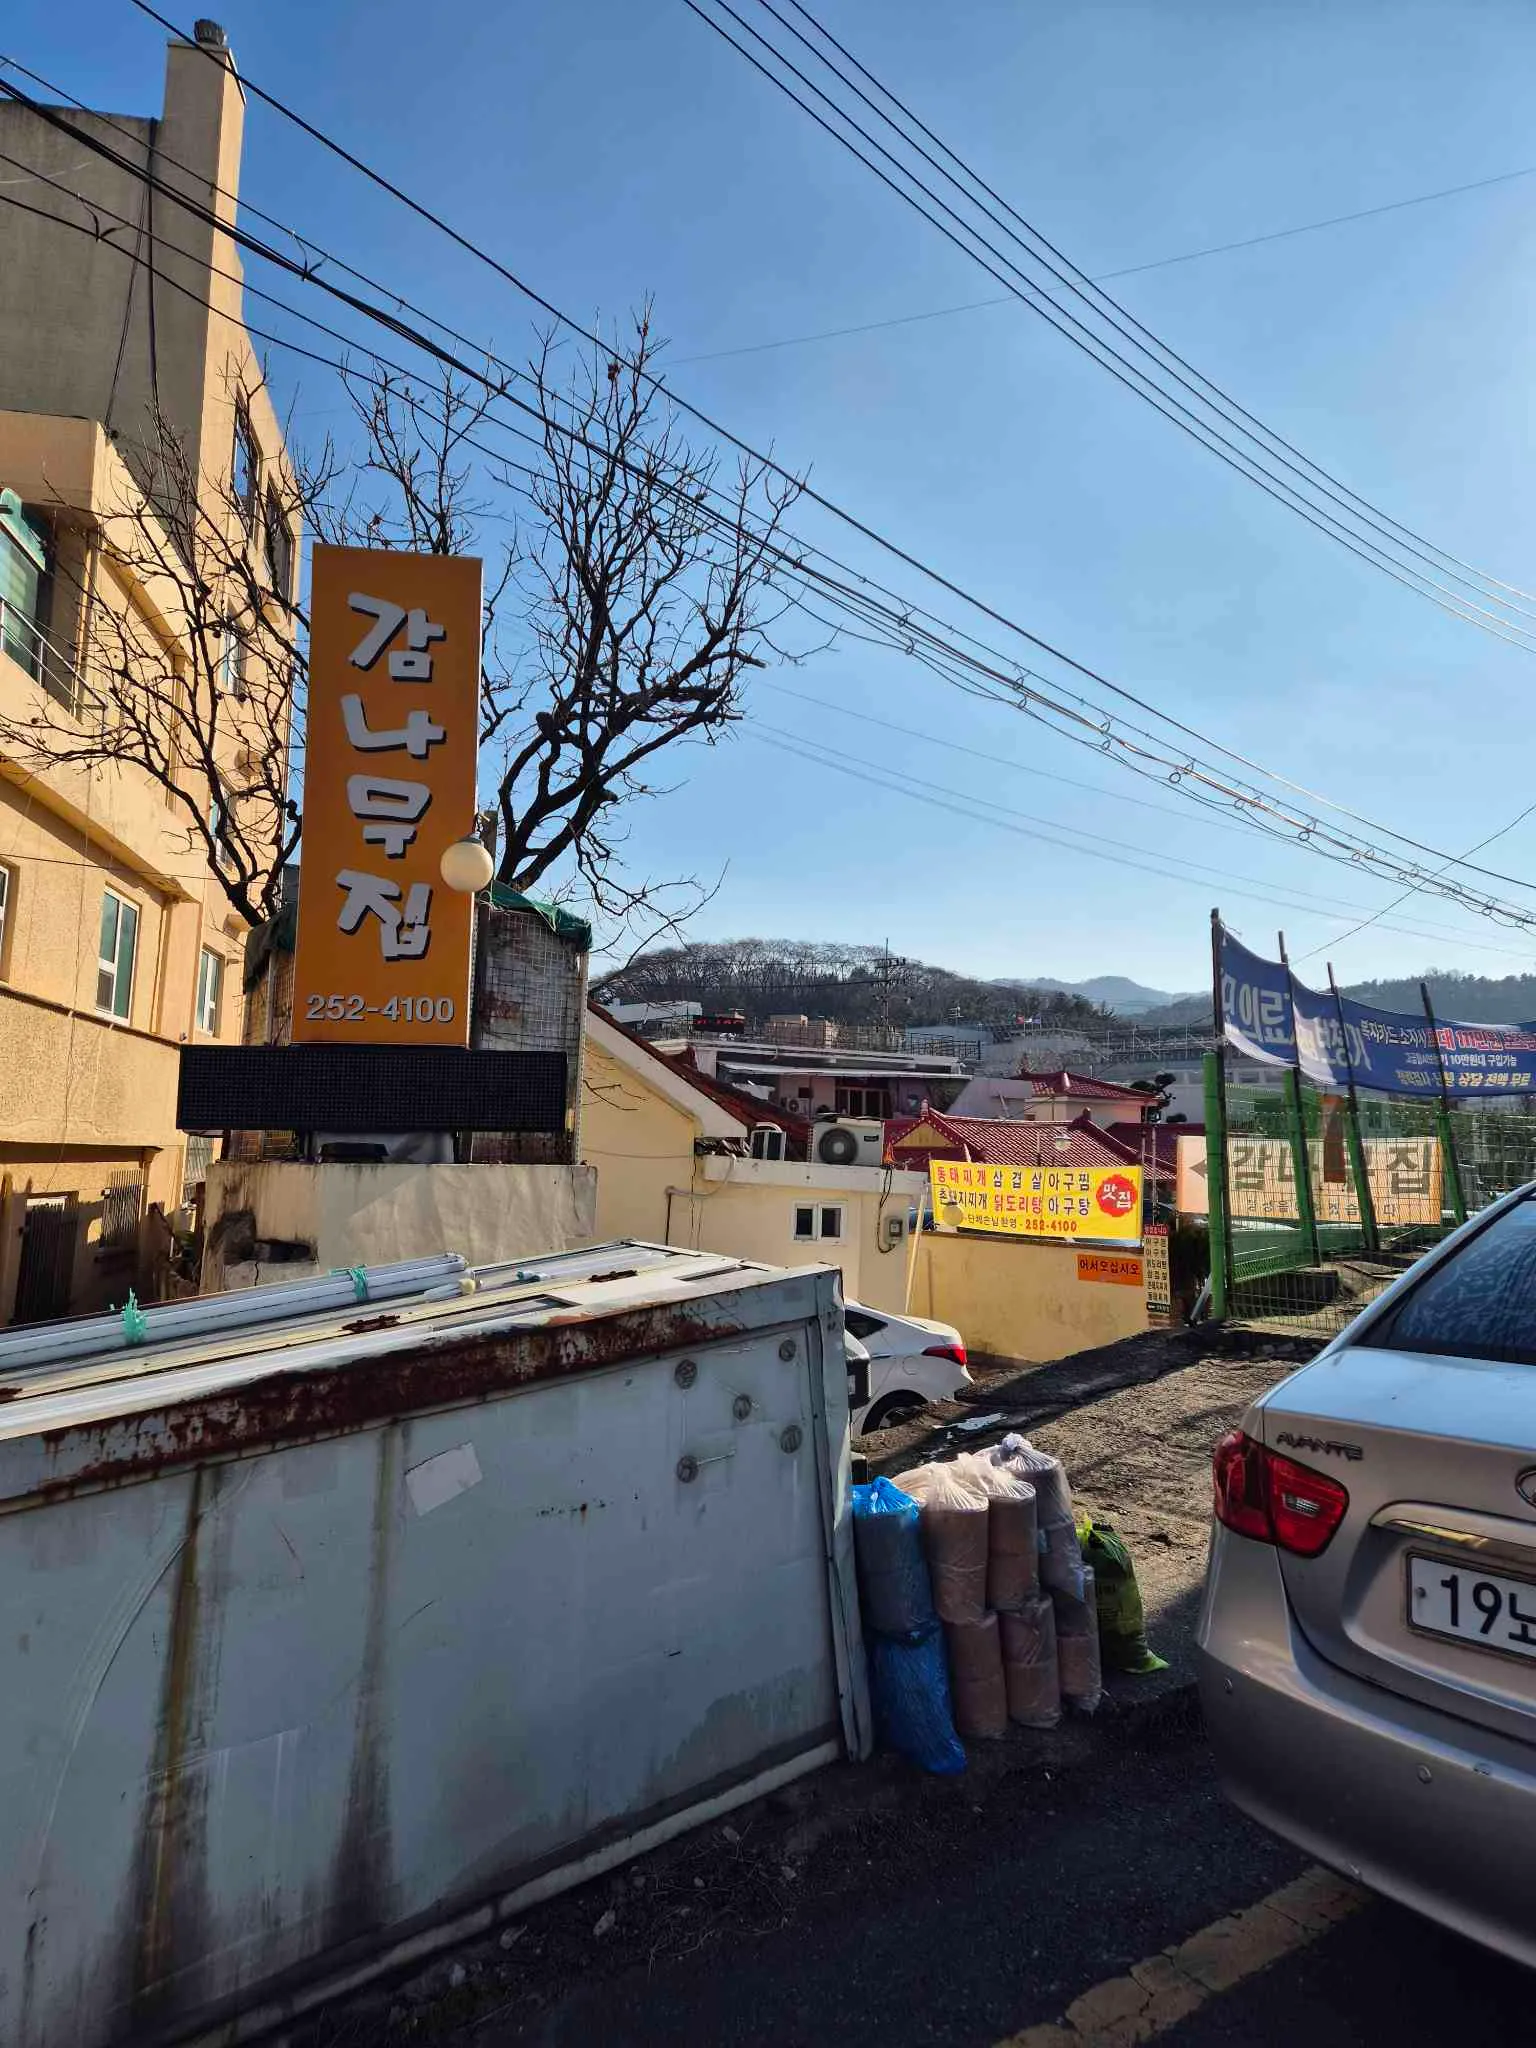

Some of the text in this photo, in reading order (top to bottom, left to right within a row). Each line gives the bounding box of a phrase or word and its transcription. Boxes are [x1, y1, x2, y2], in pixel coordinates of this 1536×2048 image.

[335, 590, 448, 963] 감나무집
[304, 993, 456, 1025] 252-4100
[1049, 1170, 1090, 1192] 아구찜
[1232, 1143, 1432, 1195] 감나집
[1049, 1195, 1091, 1216] 아구탕
[1102, 1182, 1133, 1209] 맛집
[1025, 1218, 1077, 1233] 252-4100
[1079, 1258, 1141, 1276] 어서오십시오
[1276, 1431, 1364, 1462] AVANTE
